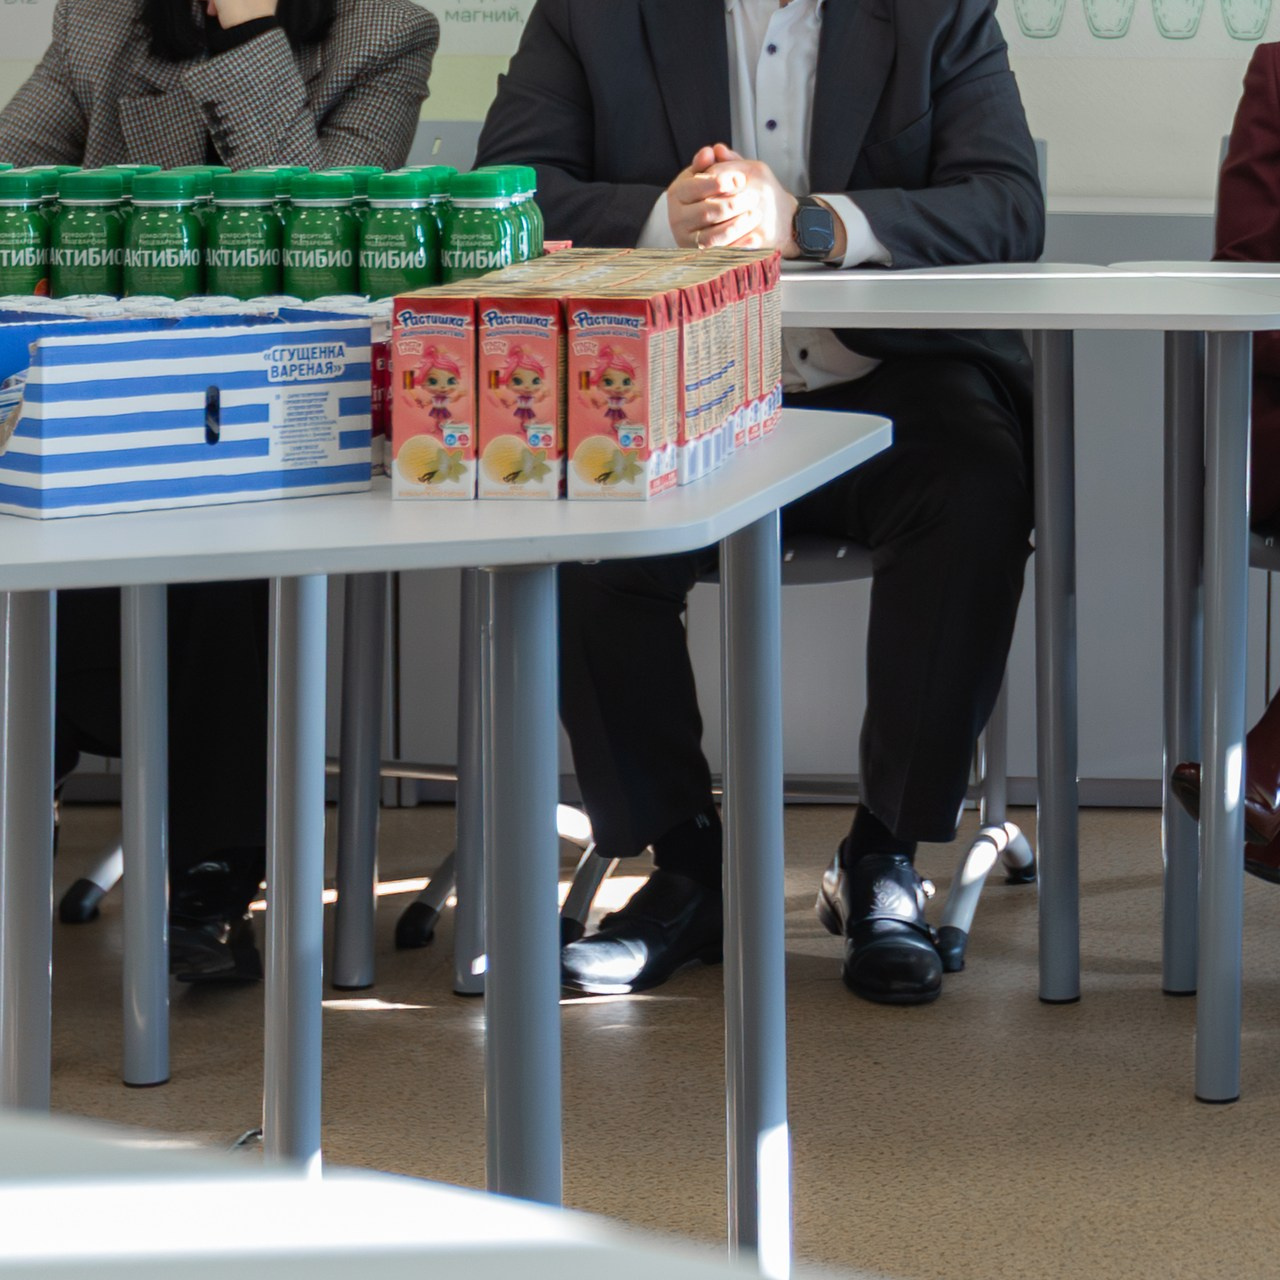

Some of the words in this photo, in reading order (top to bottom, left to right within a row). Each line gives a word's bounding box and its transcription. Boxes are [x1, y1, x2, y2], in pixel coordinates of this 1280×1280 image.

[445, 7, 524, 24] магний,
[398, 310, 465, 328] Растишка
[483, 311, 549, 328] Растишка
[574, 311, 640, 328] Растишка
[264, 345, 345, 362] «СГУЩЕНКА
[271, 363, 341, 378] ВАРЕНАЯ»
